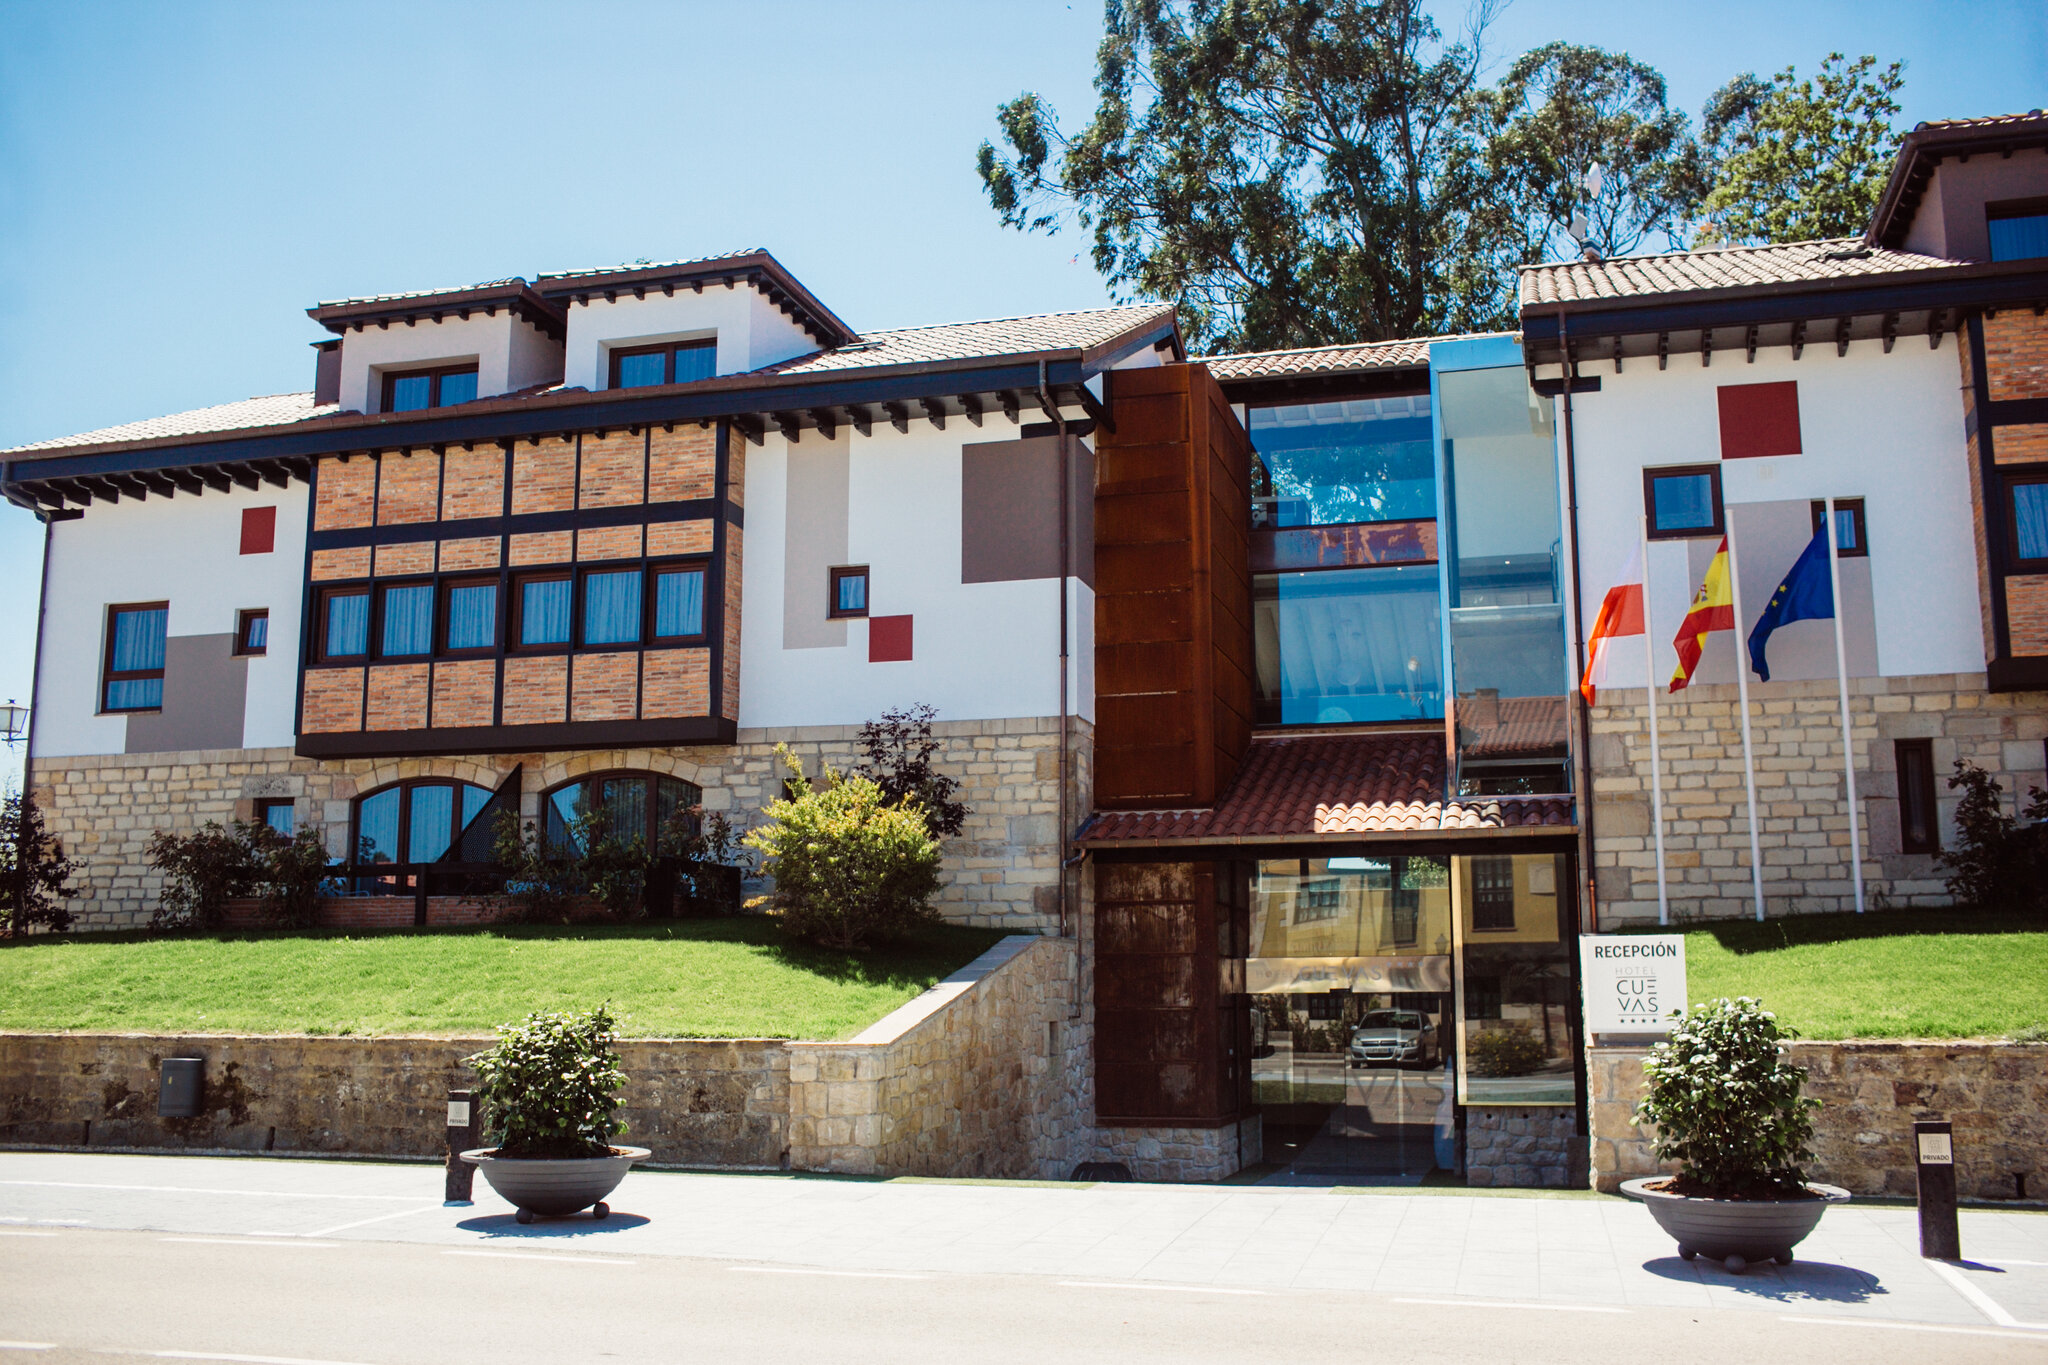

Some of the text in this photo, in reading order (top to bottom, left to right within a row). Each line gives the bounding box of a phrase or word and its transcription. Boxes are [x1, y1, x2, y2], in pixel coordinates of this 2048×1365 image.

[1595, 941, 1677, 958] RECEPCIÓN
[1615, 966, 1656, 975] HOTEL
[1616, 979, 1658, 995] CUE
[1617, 996, 1659, 1013] VAS
